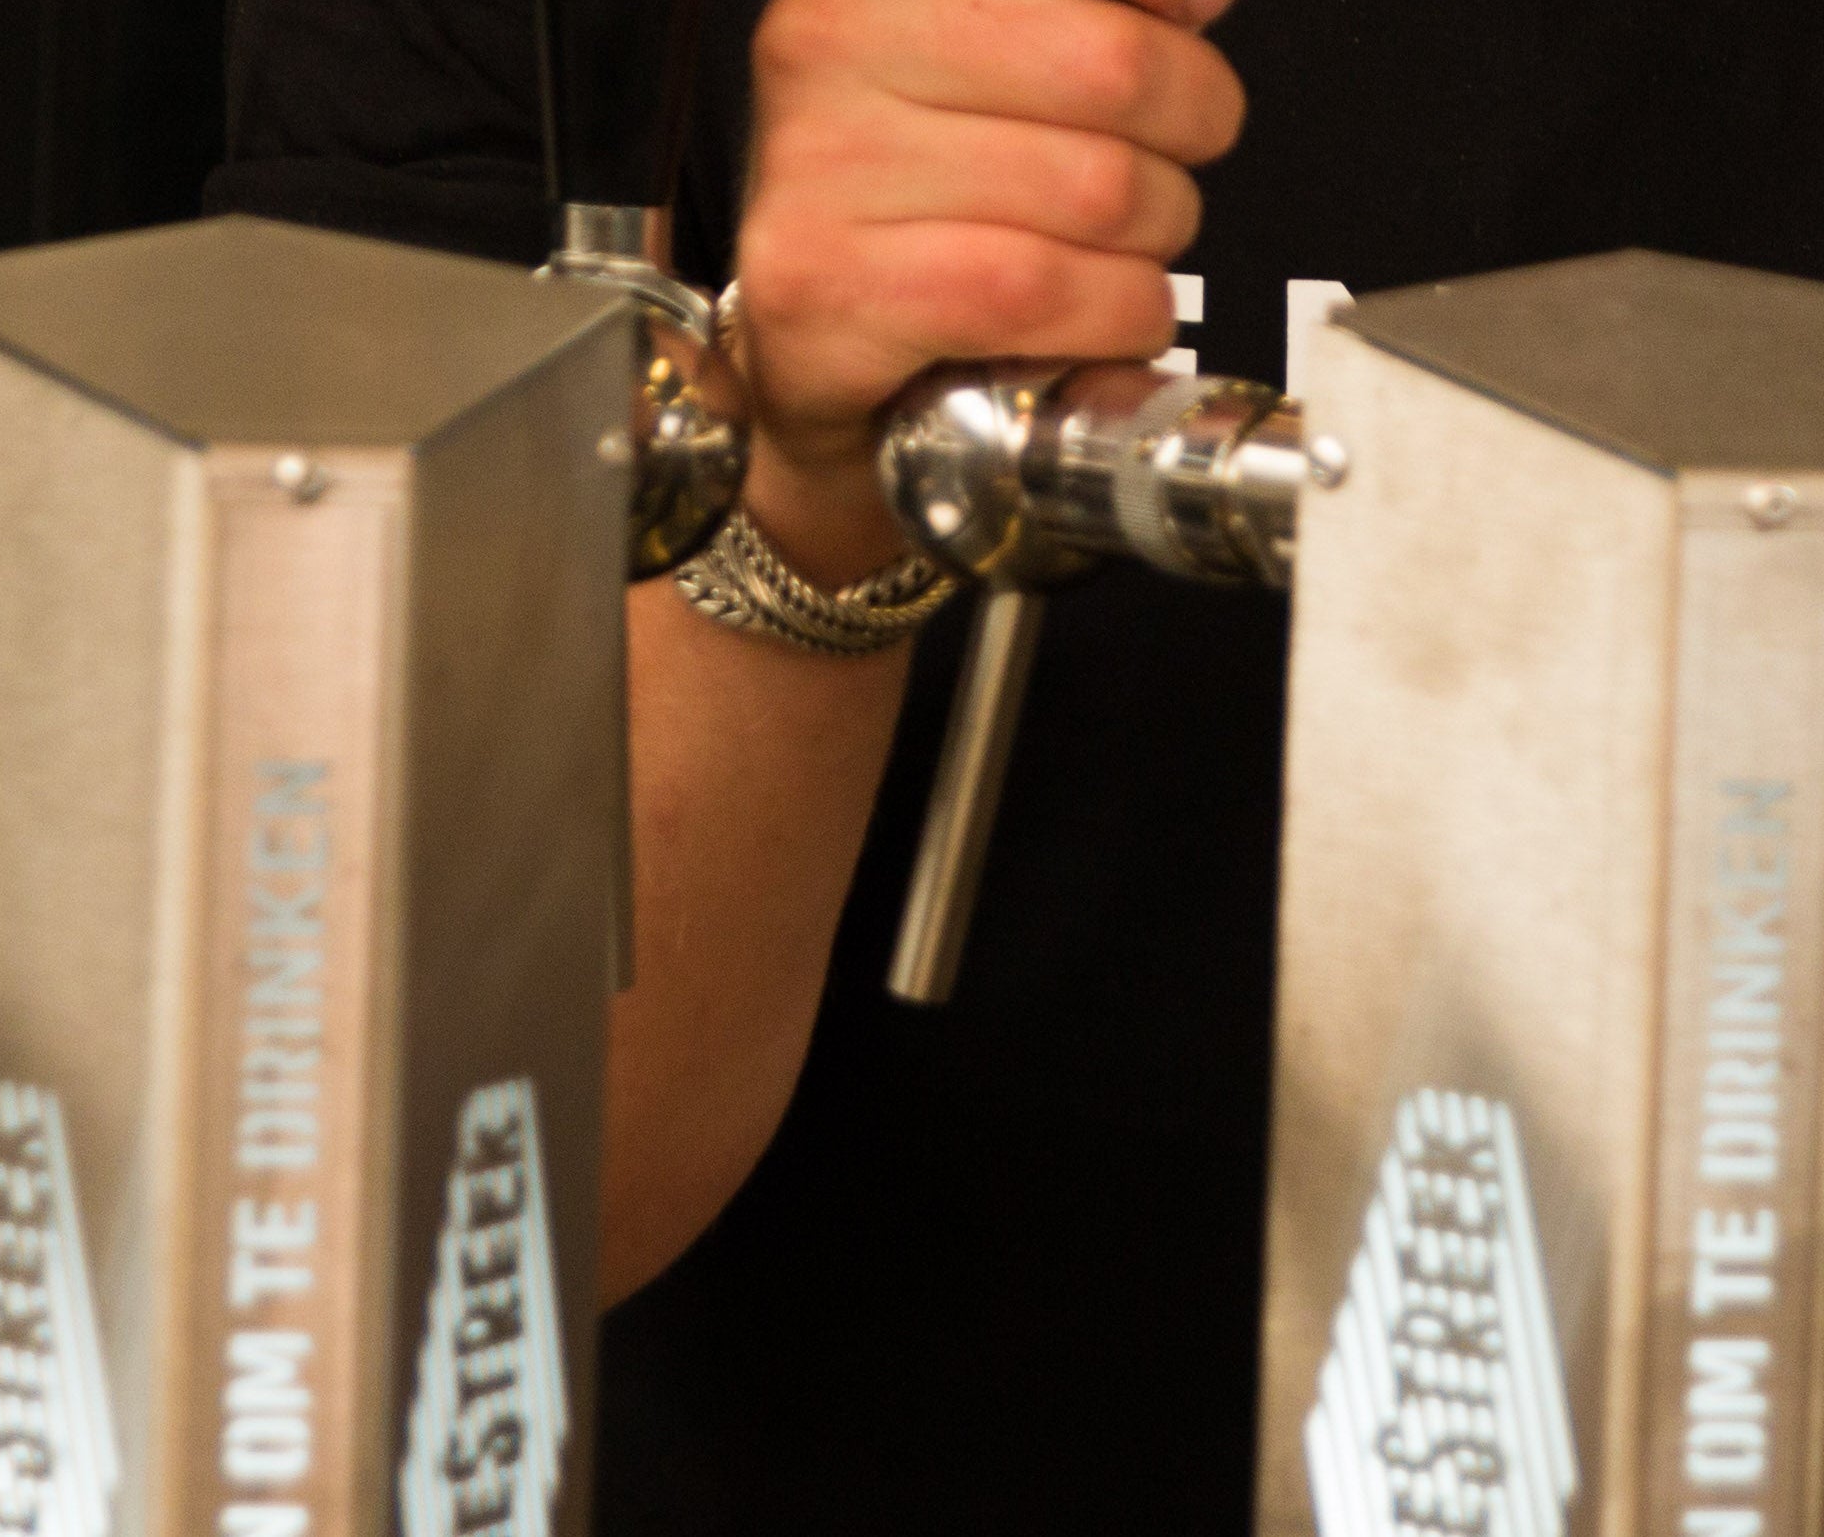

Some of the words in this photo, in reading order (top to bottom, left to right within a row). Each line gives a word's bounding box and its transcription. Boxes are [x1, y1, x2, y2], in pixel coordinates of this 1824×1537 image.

[238, 759, 333, 1169] DRINKEN
[1700, 777, 1795, 1183] DRINKEN
[228, 1197, 318, 1306] TE
[1692, 1209, 1775, 1315] TE
[223, 1329, 314, 1483] OM
[1683, 1339, 1770, 1483] OM
